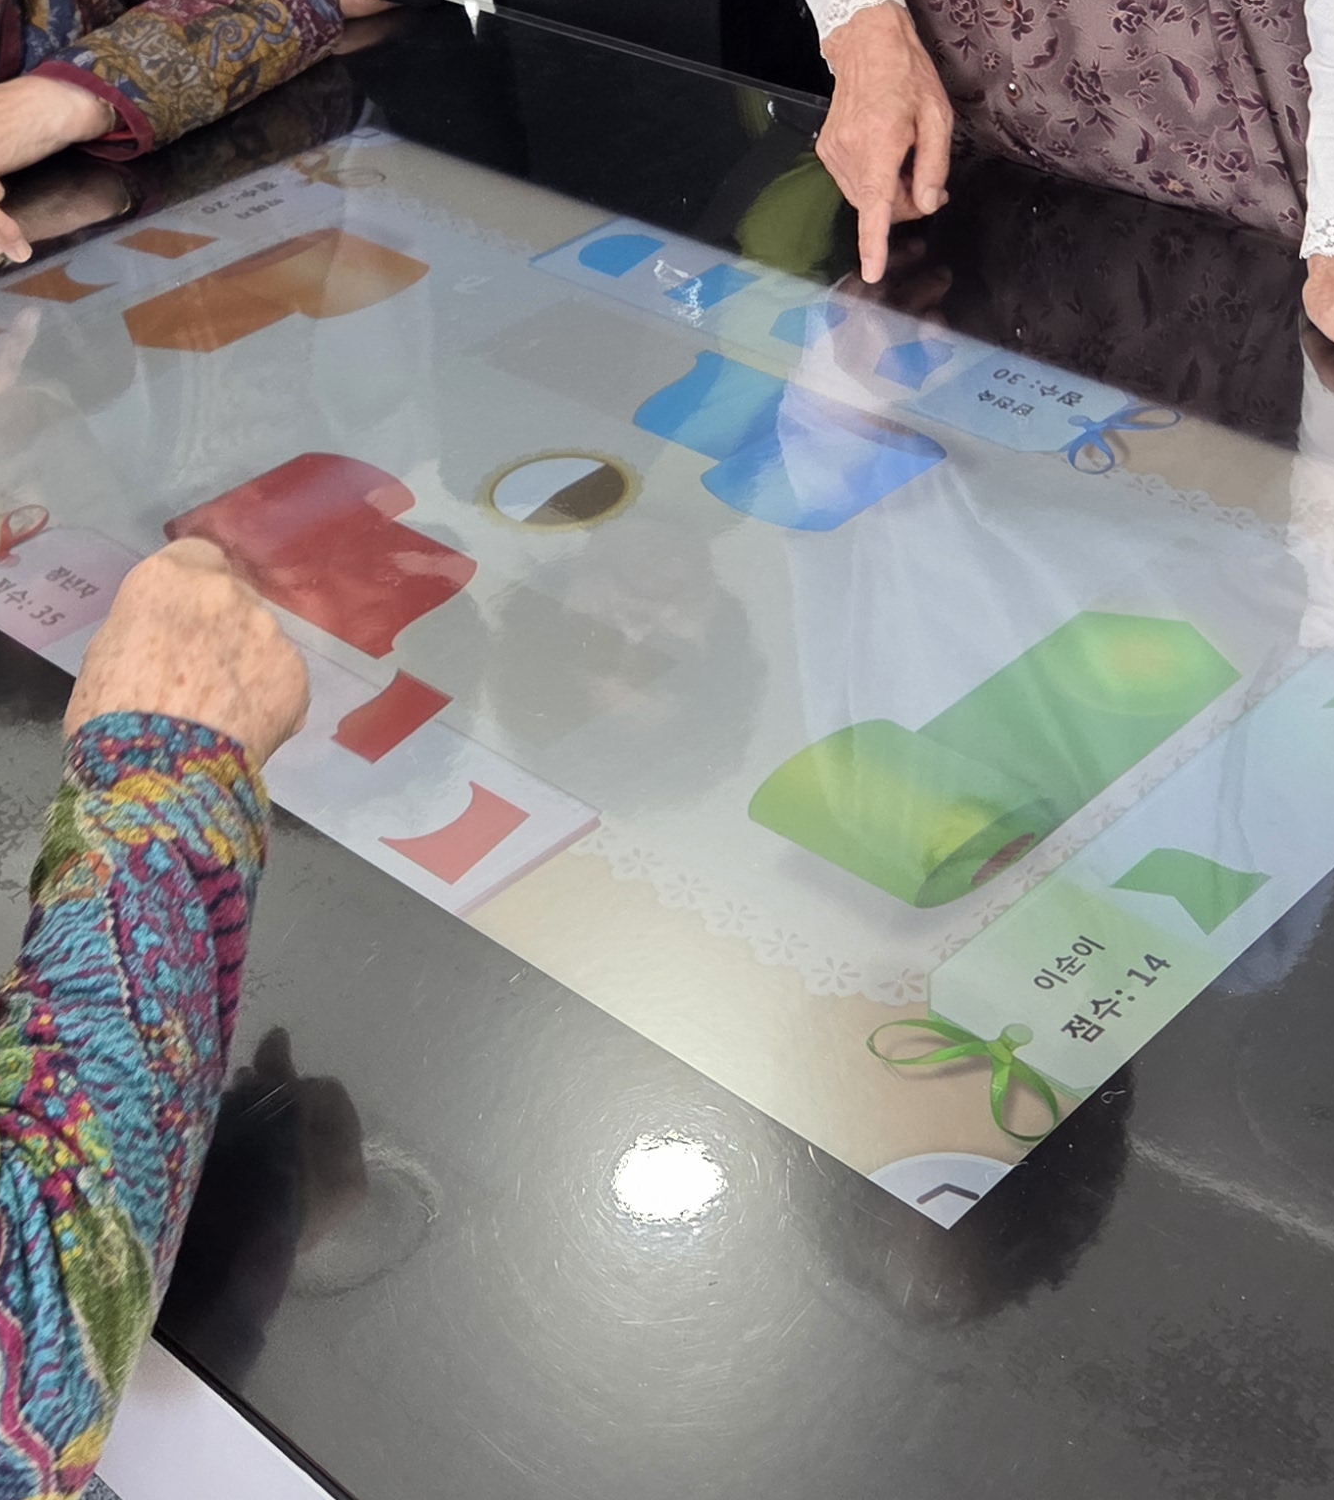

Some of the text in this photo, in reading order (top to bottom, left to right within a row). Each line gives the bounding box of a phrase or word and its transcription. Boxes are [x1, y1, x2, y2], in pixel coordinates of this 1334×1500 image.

[993, 368, 1084, 407] 점수: 30
[29, 605, 66, 626] 35
[1034, 935, 1106, 990] 이순이
[1060, 954, 1172, 1043] 점수: 14
